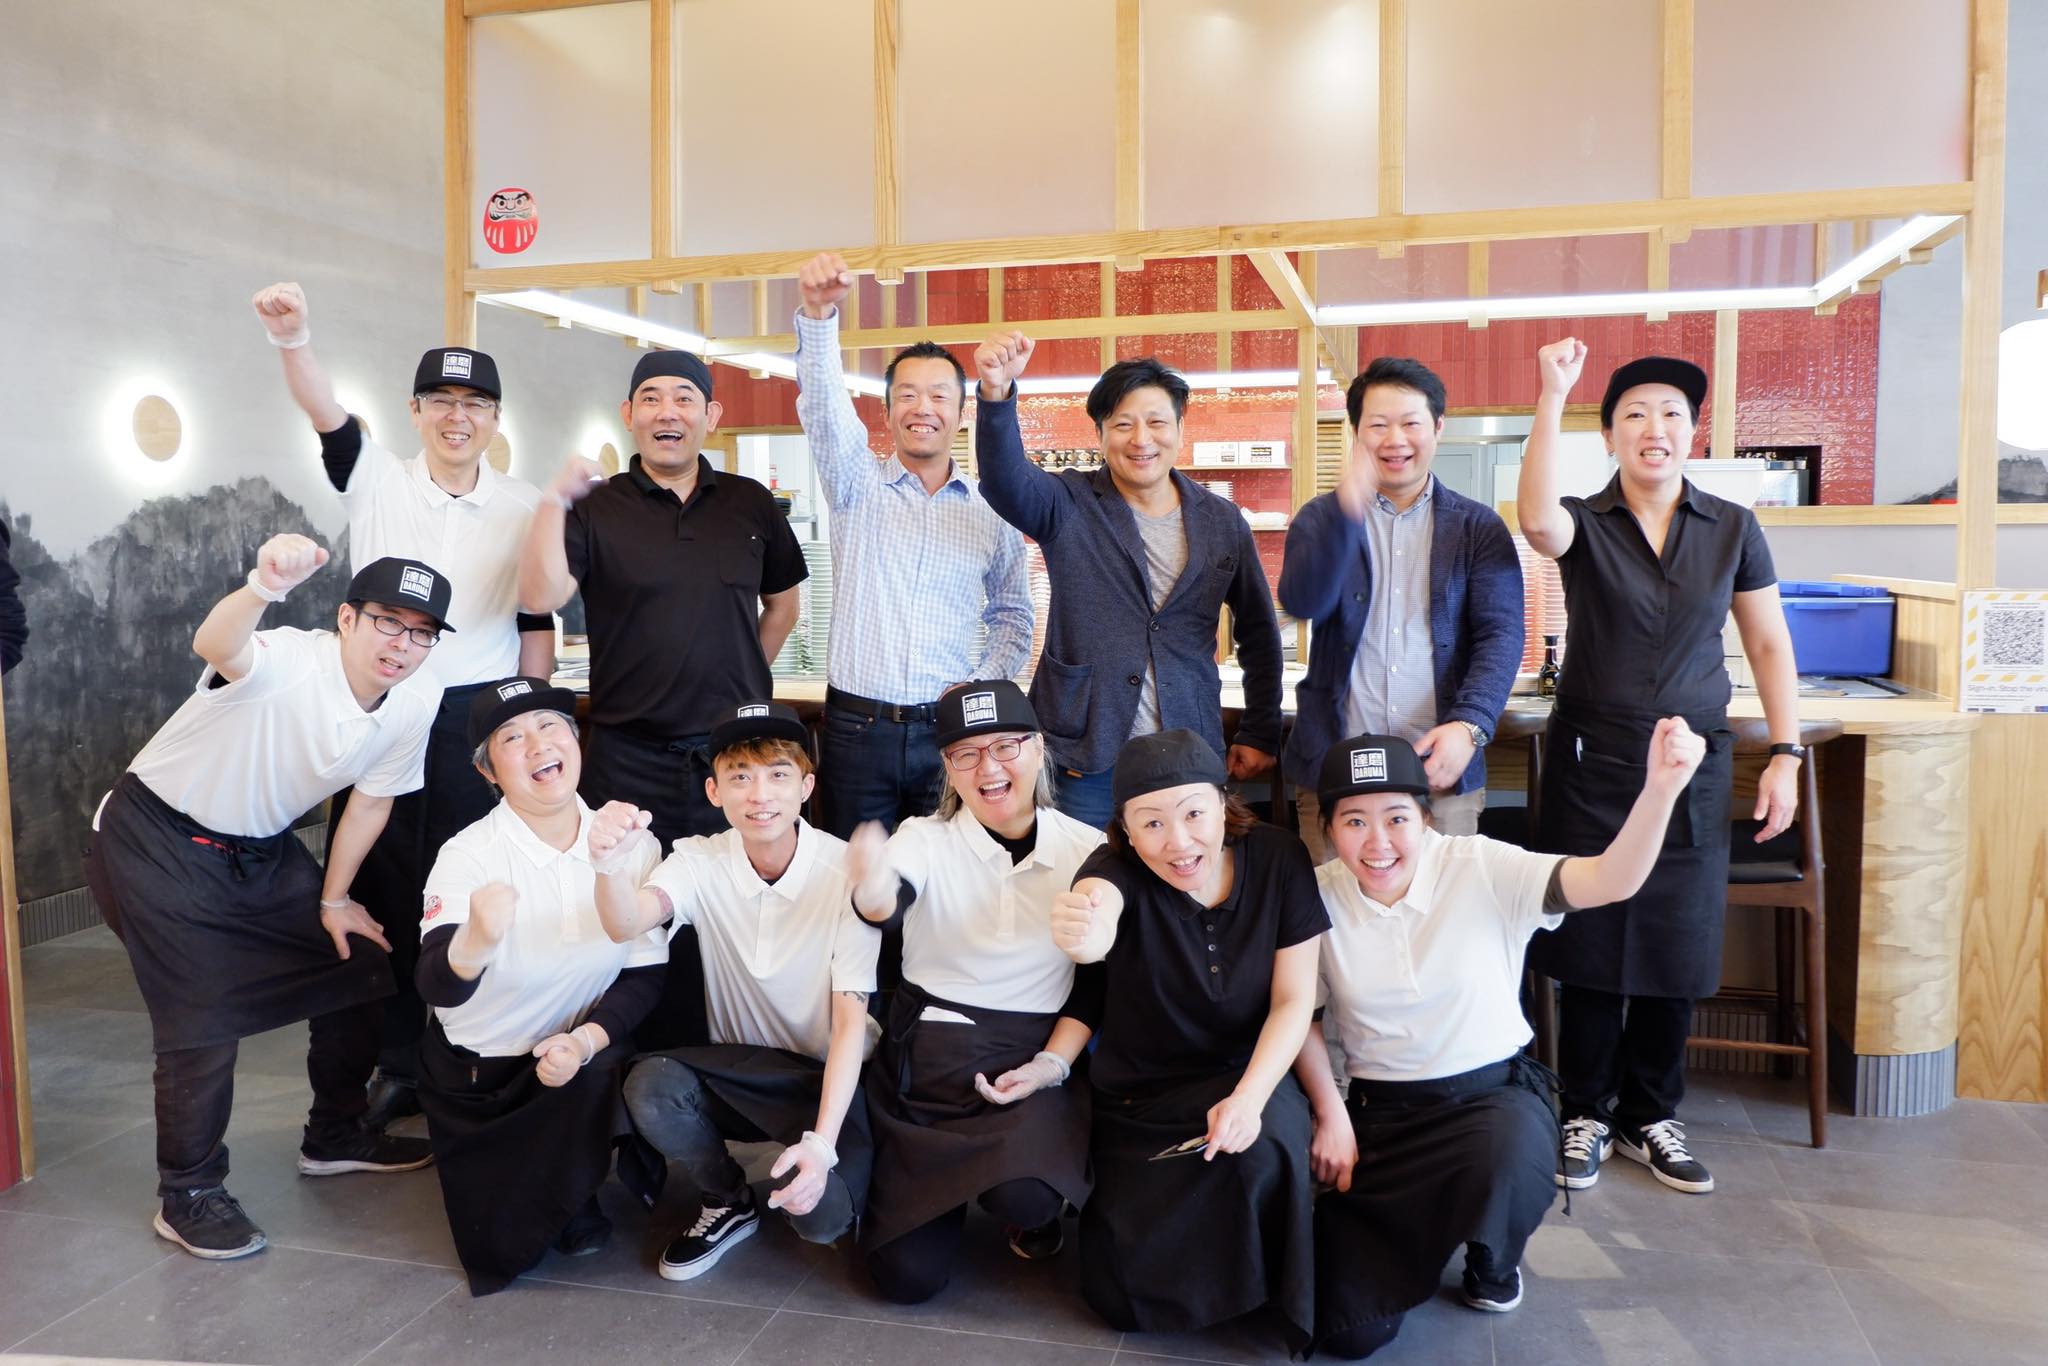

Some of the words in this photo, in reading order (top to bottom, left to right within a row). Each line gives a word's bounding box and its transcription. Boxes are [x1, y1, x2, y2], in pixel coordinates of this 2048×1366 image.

[445, 365, 468, 375] DARUMA
[402, 580, 428, 597] DARUMA
[966, 708, 994, 722] DARUMA
[1354, 766, 1384, 779] DARUMA
